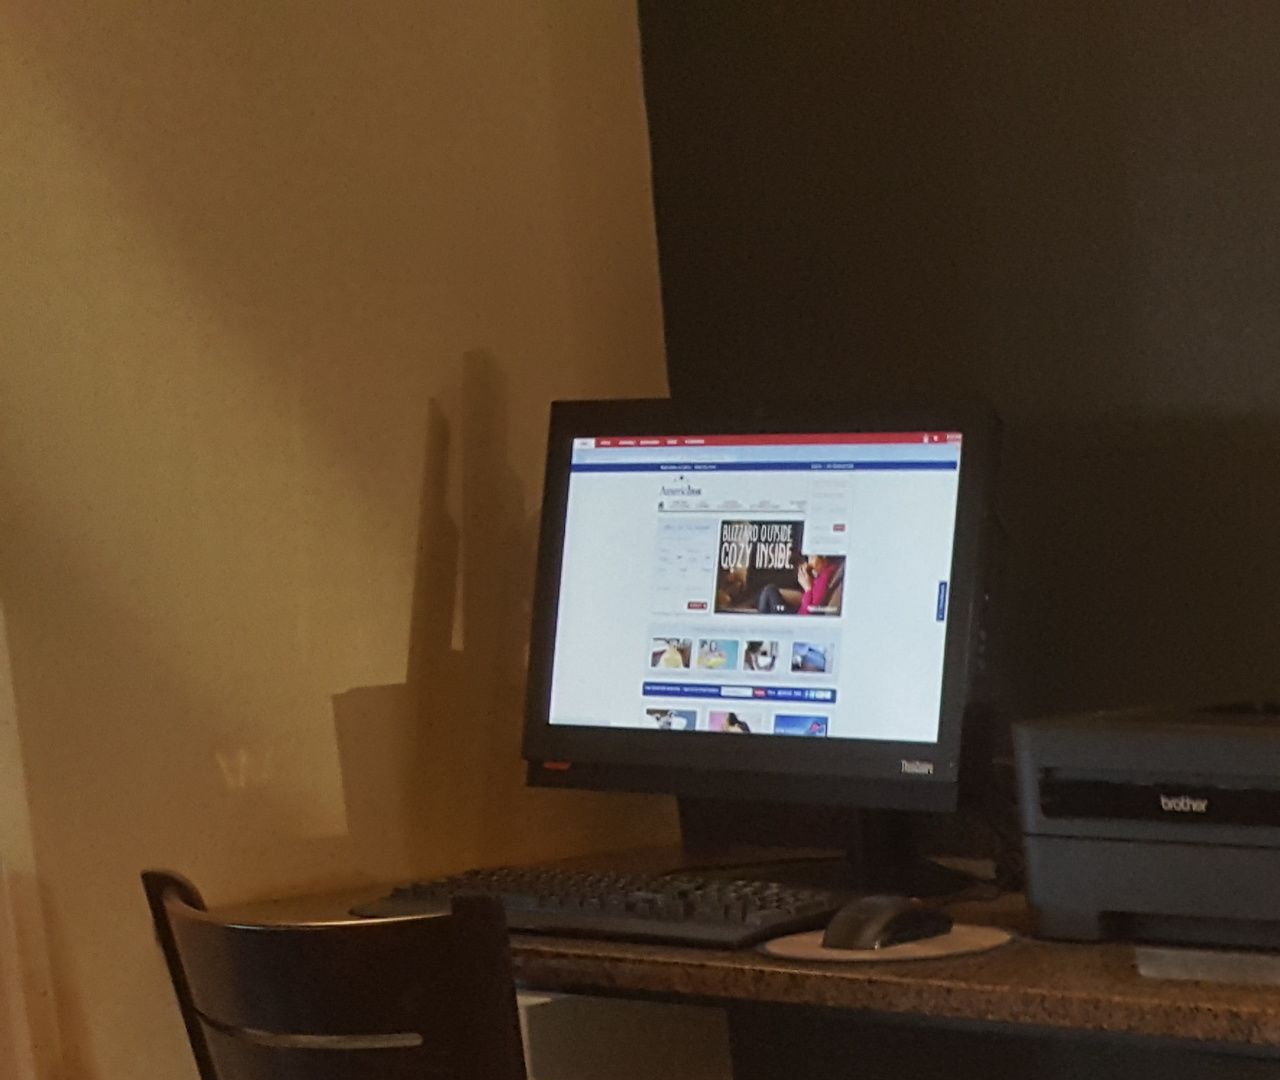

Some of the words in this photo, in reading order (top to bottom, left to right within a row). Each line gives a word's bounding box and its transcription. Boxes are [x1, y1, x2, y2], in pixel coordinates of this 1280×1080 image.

[722, 523, 759, 542] BLIZZARD
[721, 542, 753, 570] COZY
[1160, 794, 1208, 813] brother
